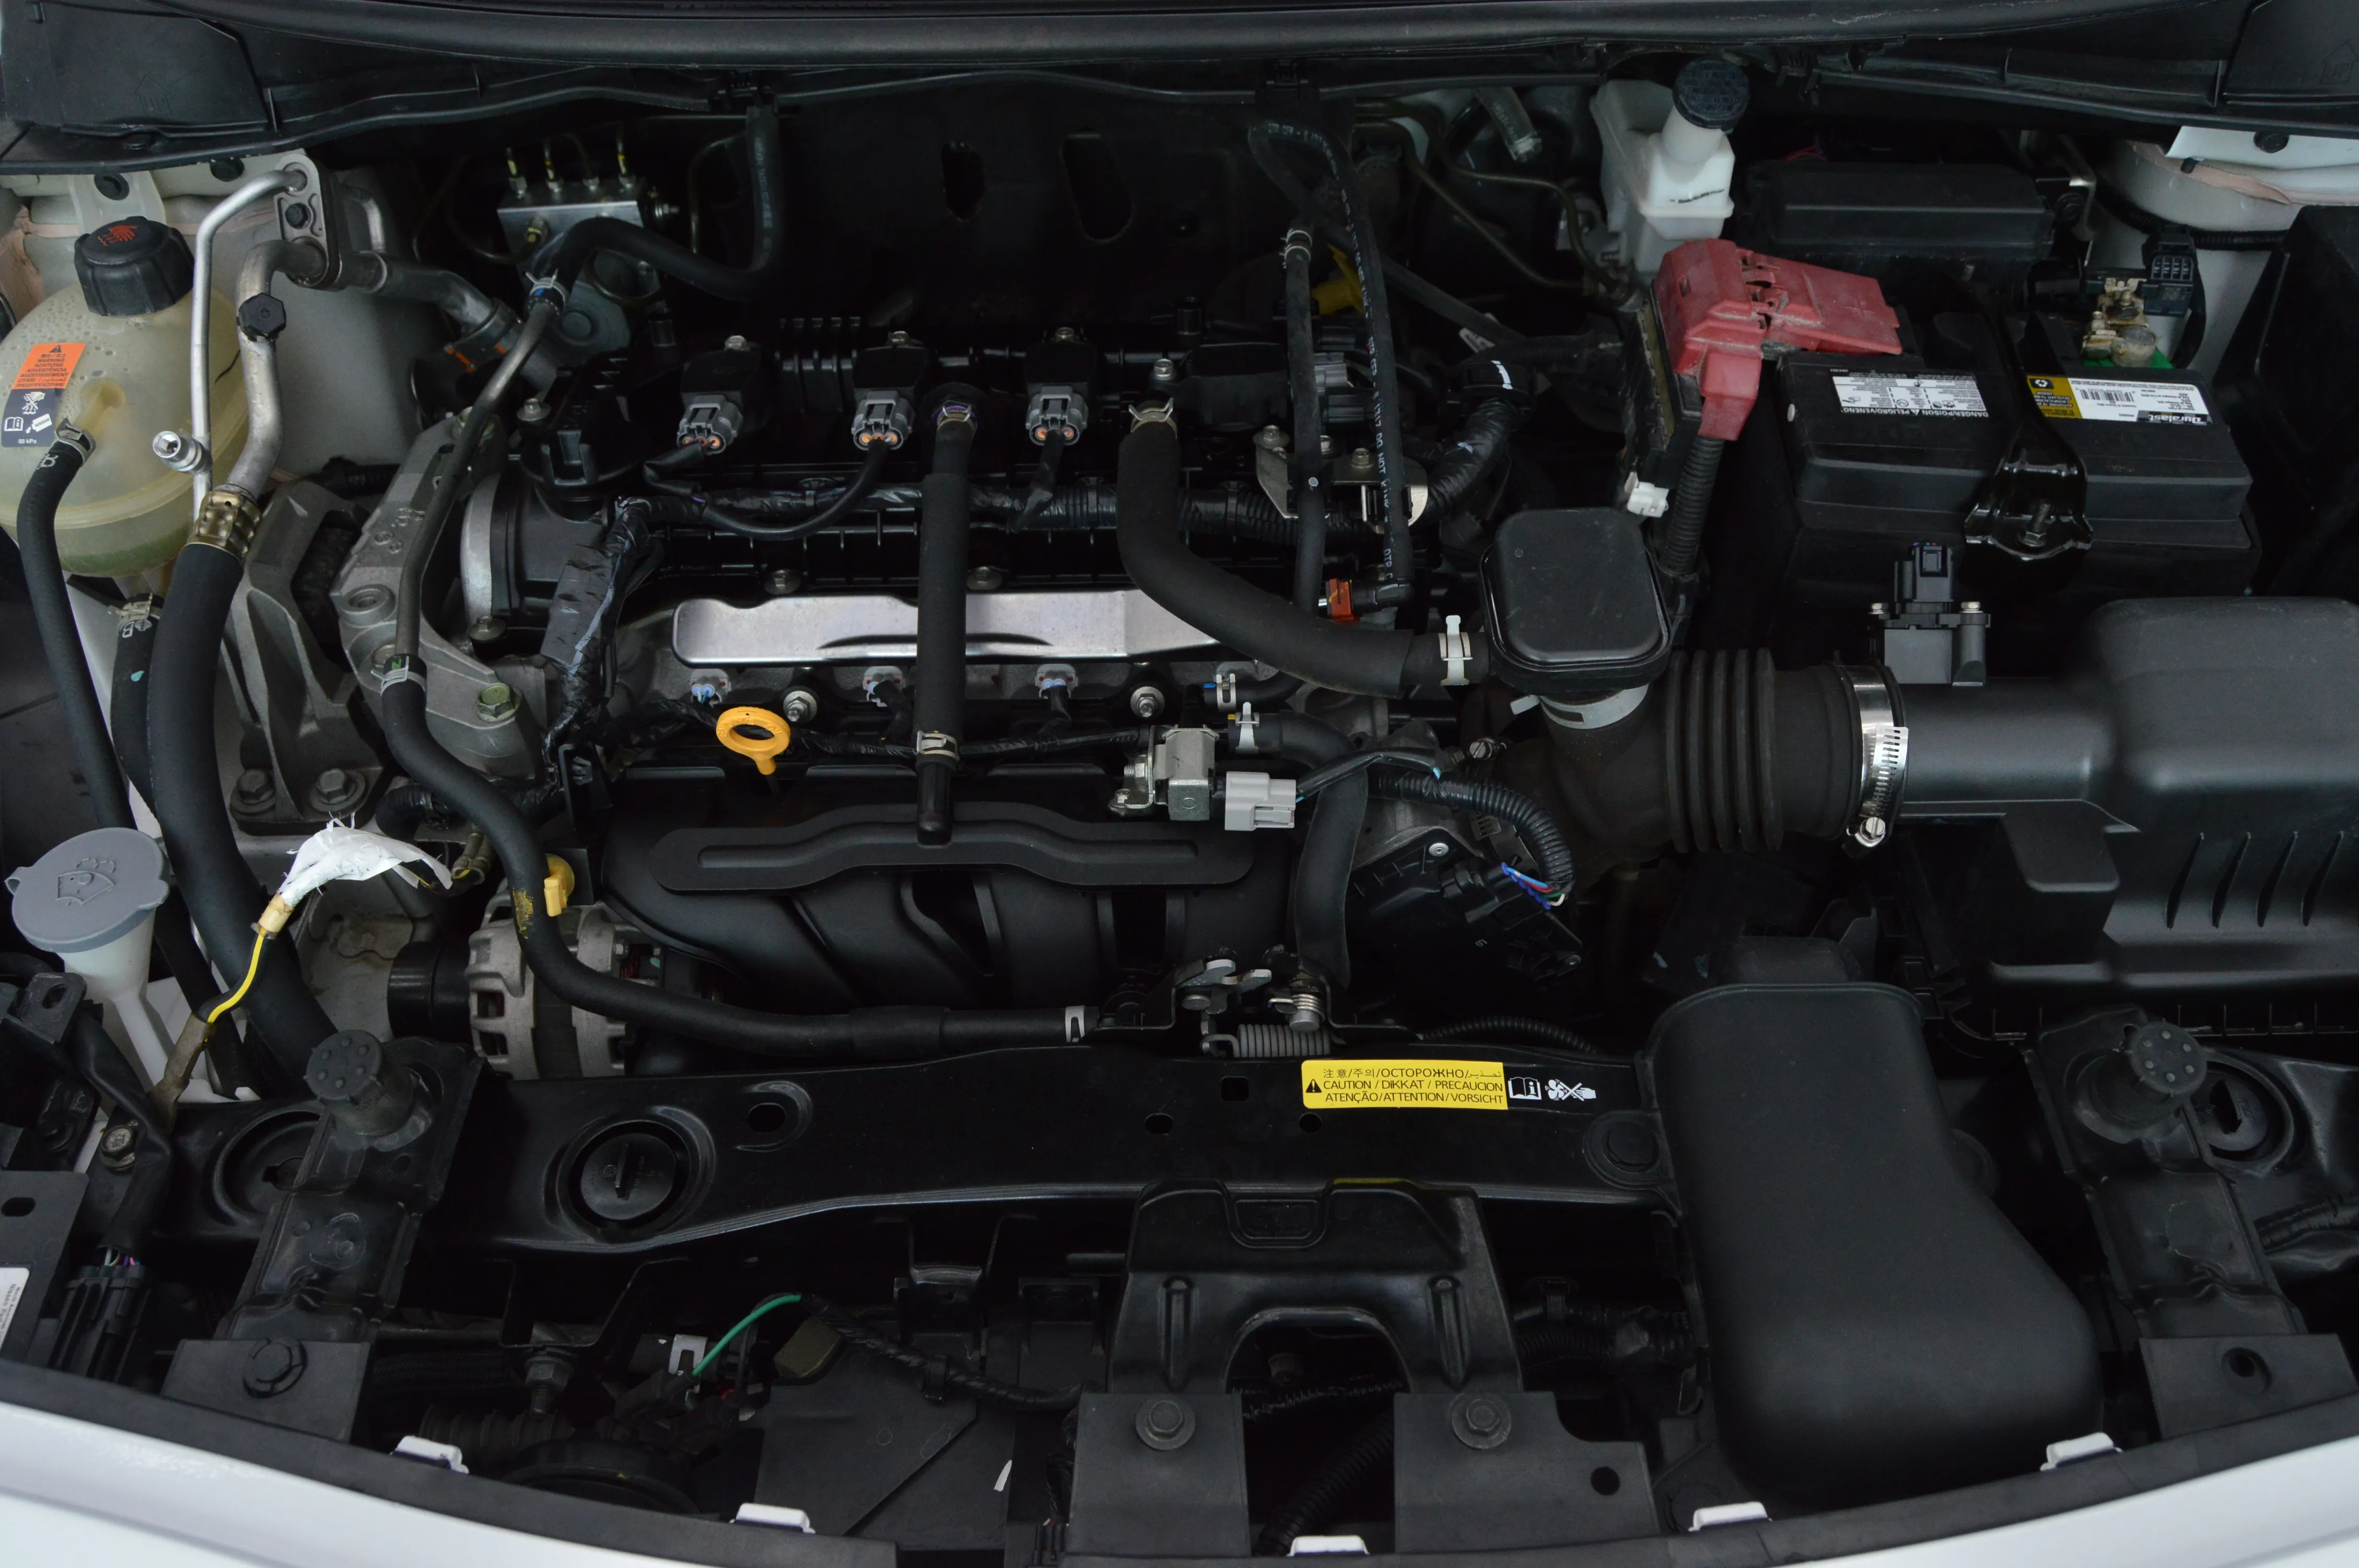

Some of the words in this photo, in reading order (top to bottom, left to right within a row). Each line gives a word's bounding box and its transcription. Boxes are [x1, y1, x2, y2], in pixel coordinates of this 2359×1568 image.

[35, 418, 50, 428] NISSAN
[2148, 414, 2205, 424] Duralast
[1378, 452, 1387, 474] NOT
[1323, 1080, 1371, 1089] CAUTION
[1435, 1080, 1503, 1091] PRECAUCION
